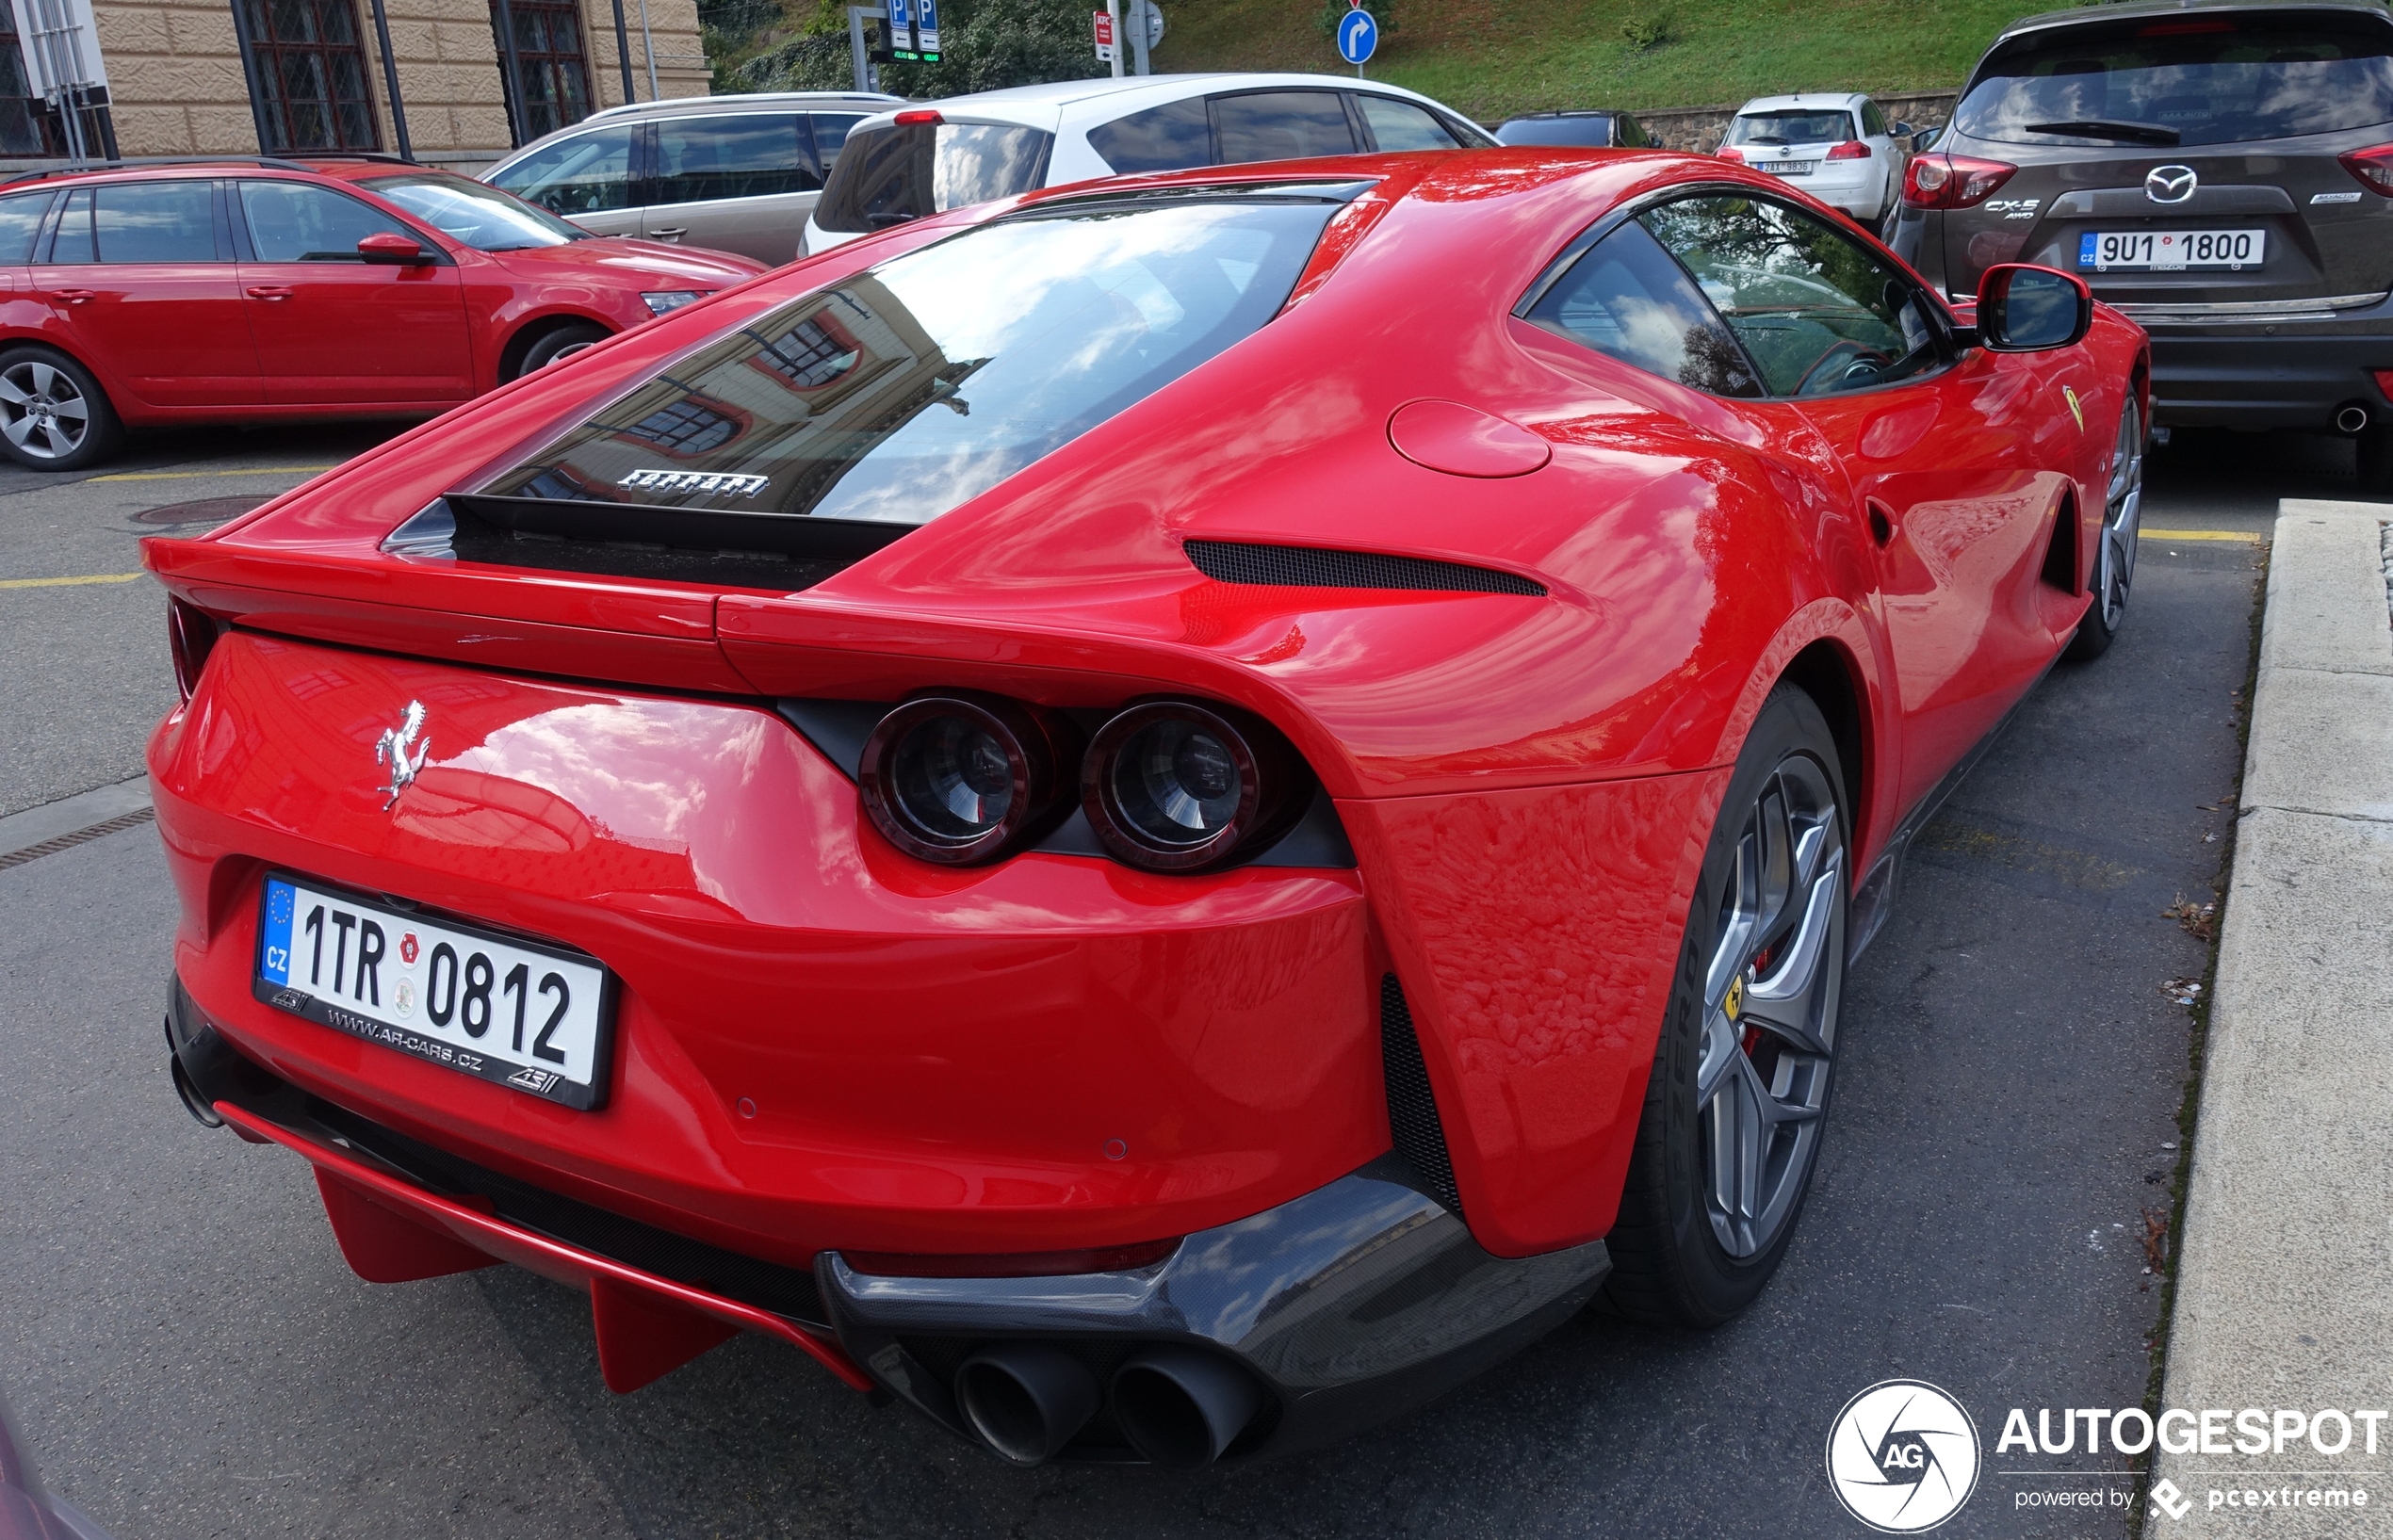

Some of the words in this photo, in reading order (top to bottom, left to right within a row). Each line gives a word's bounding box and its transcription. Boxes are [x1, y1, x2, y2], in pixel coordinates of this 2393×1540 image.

[920, 0, 932, 22] P
[1097, 15, 1110, 25] KFC
[1765, 163, 1780, 171] 2AX
[1786, 162, 1808, 171] 9836
[1984, 199, 2041, 213] CX-5
[2004, 212, 2035, 220] AWD
[2080, 253, 2094, 263] CZ
[2102, 235, 2154, 262] 9U1
[2181, 234, 2251, 261] 1800
[617, 469, 770, 498] Ferrari
[267, 945, 287, 973] CZ
[304, 904, 387, 1008] 1TR
[426, 942, 572, 1065] 0812
[328, 1010, 484, 1072] WWW.AR-CARS.CZ
